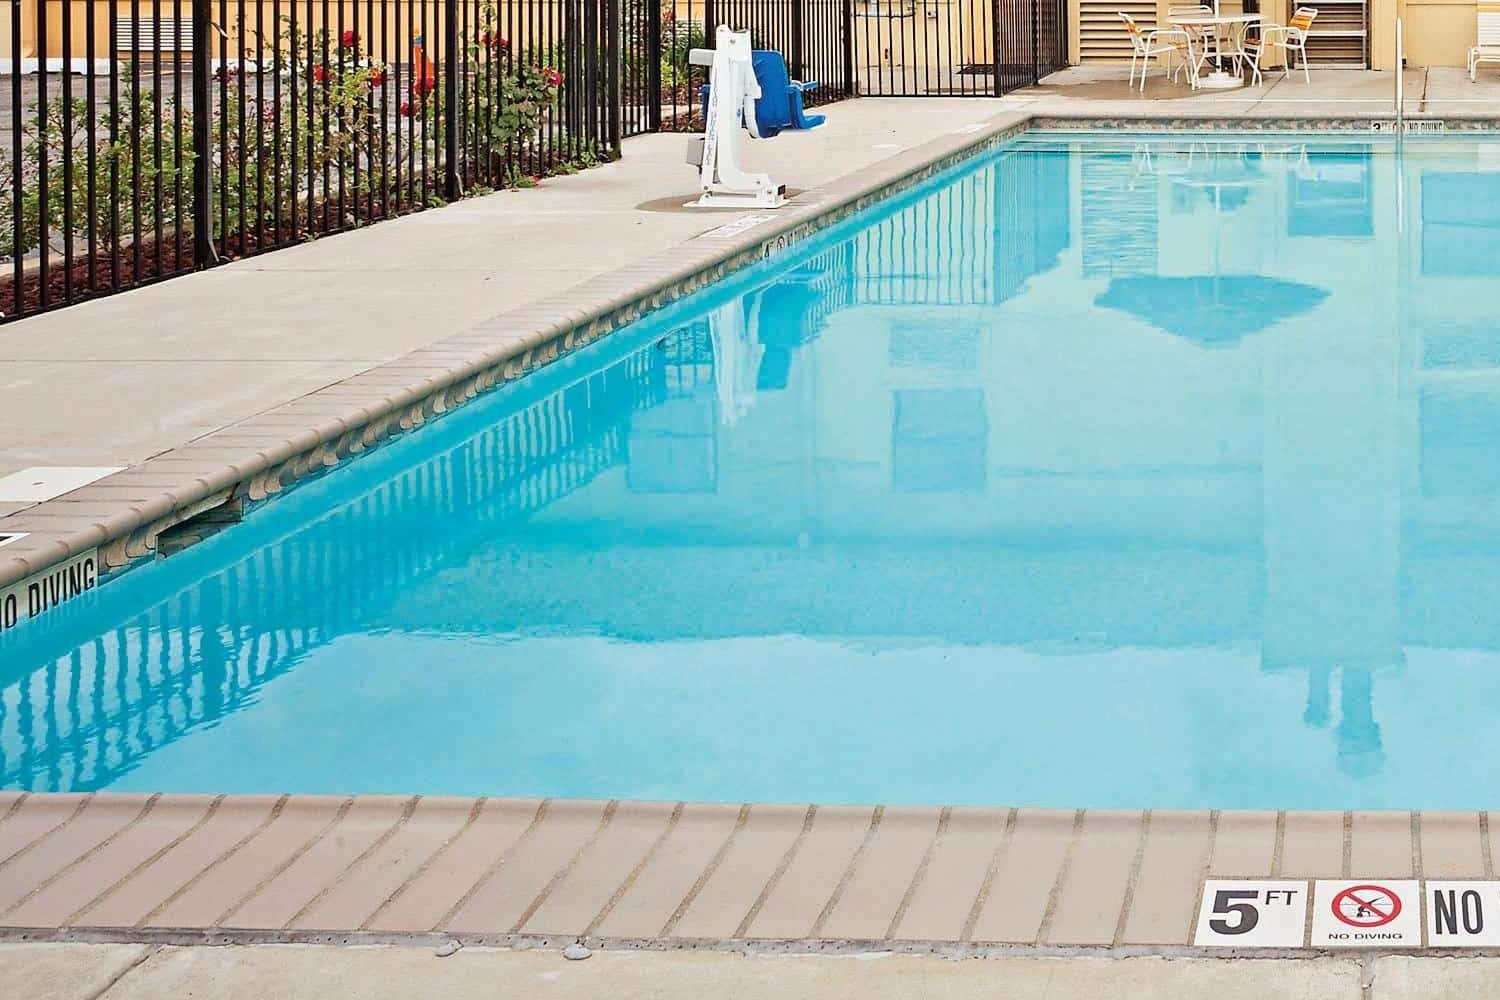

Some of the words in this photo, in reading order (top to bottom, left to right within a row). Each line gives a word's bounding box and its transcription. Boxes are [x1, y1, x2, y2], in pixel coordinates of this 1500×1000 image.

[28, 558, 95, 618] DIVING
[1209, 890, 1260, 935] 5
[1265, 890, 1298, 905] FT
[1434, 889, 1484, 935] NO
[1328, 932, 1350, 940] NO
[1354, 932, 1404, 940] DIVING
